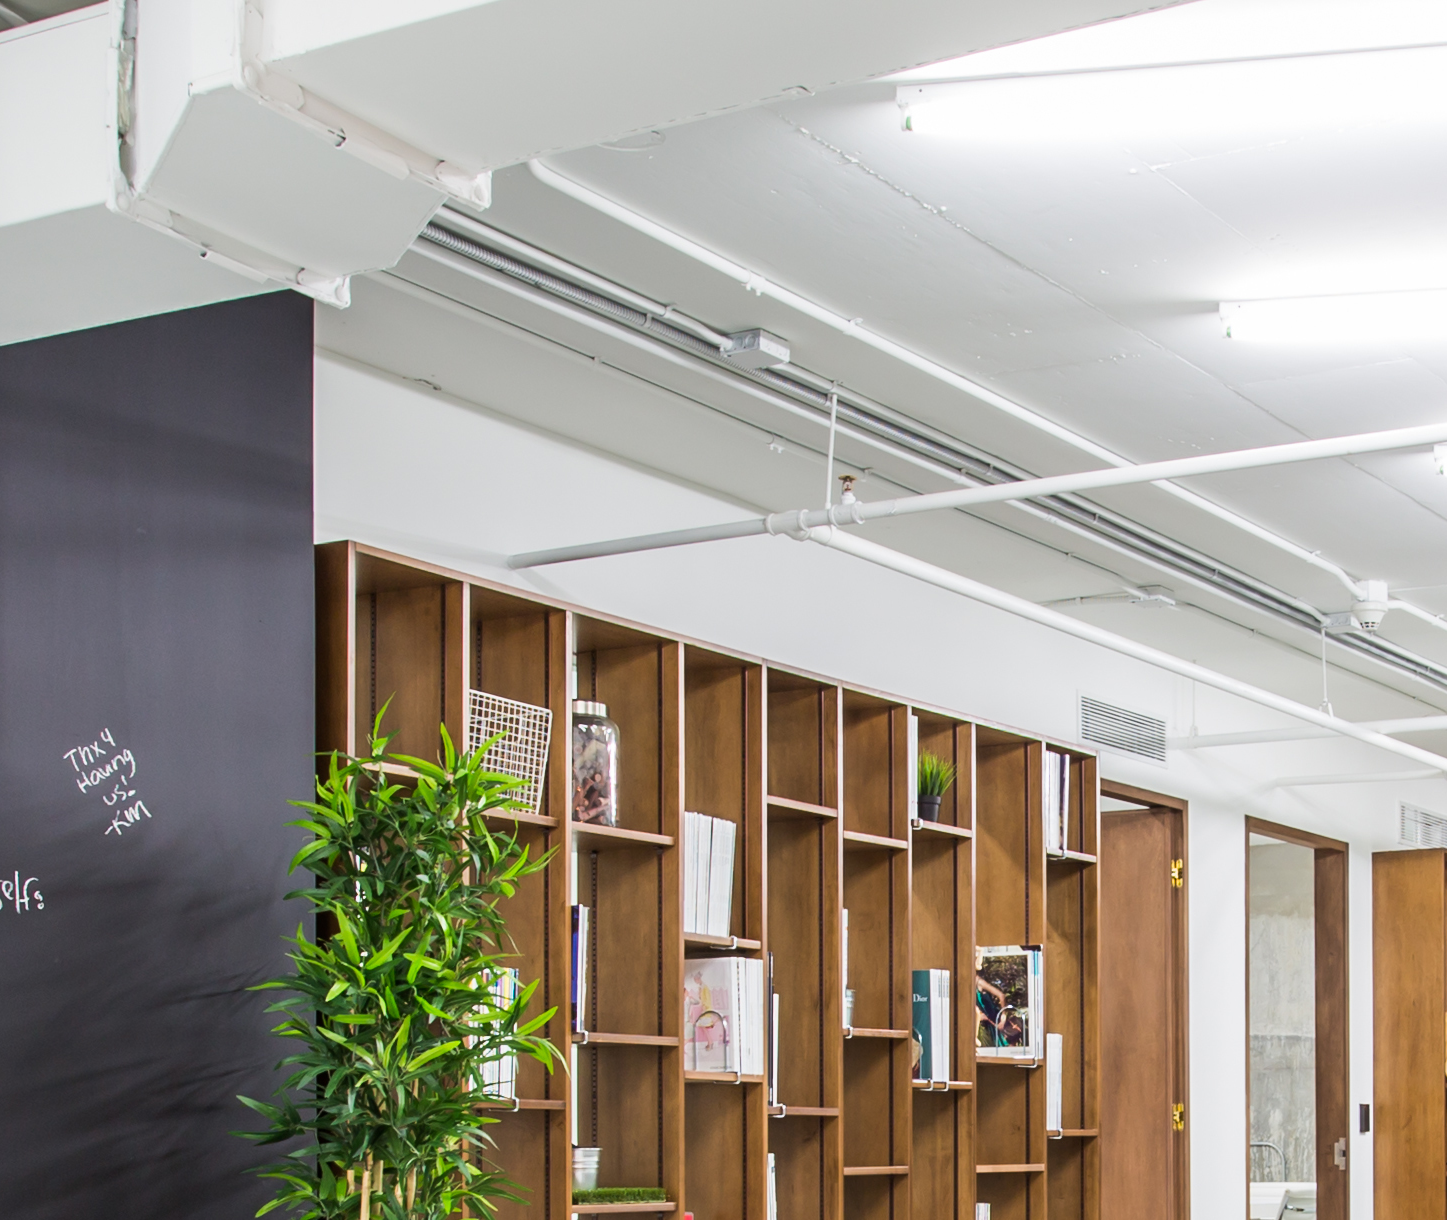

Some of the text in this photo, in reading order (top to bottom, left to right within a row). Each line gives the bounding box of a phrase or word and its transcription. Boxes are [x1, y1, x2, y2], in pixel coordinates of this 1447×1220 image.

[100, 727, 116, 747] 4
[102, 775, 136, 806] us!
[913, 993, 928, 1003] Dior
